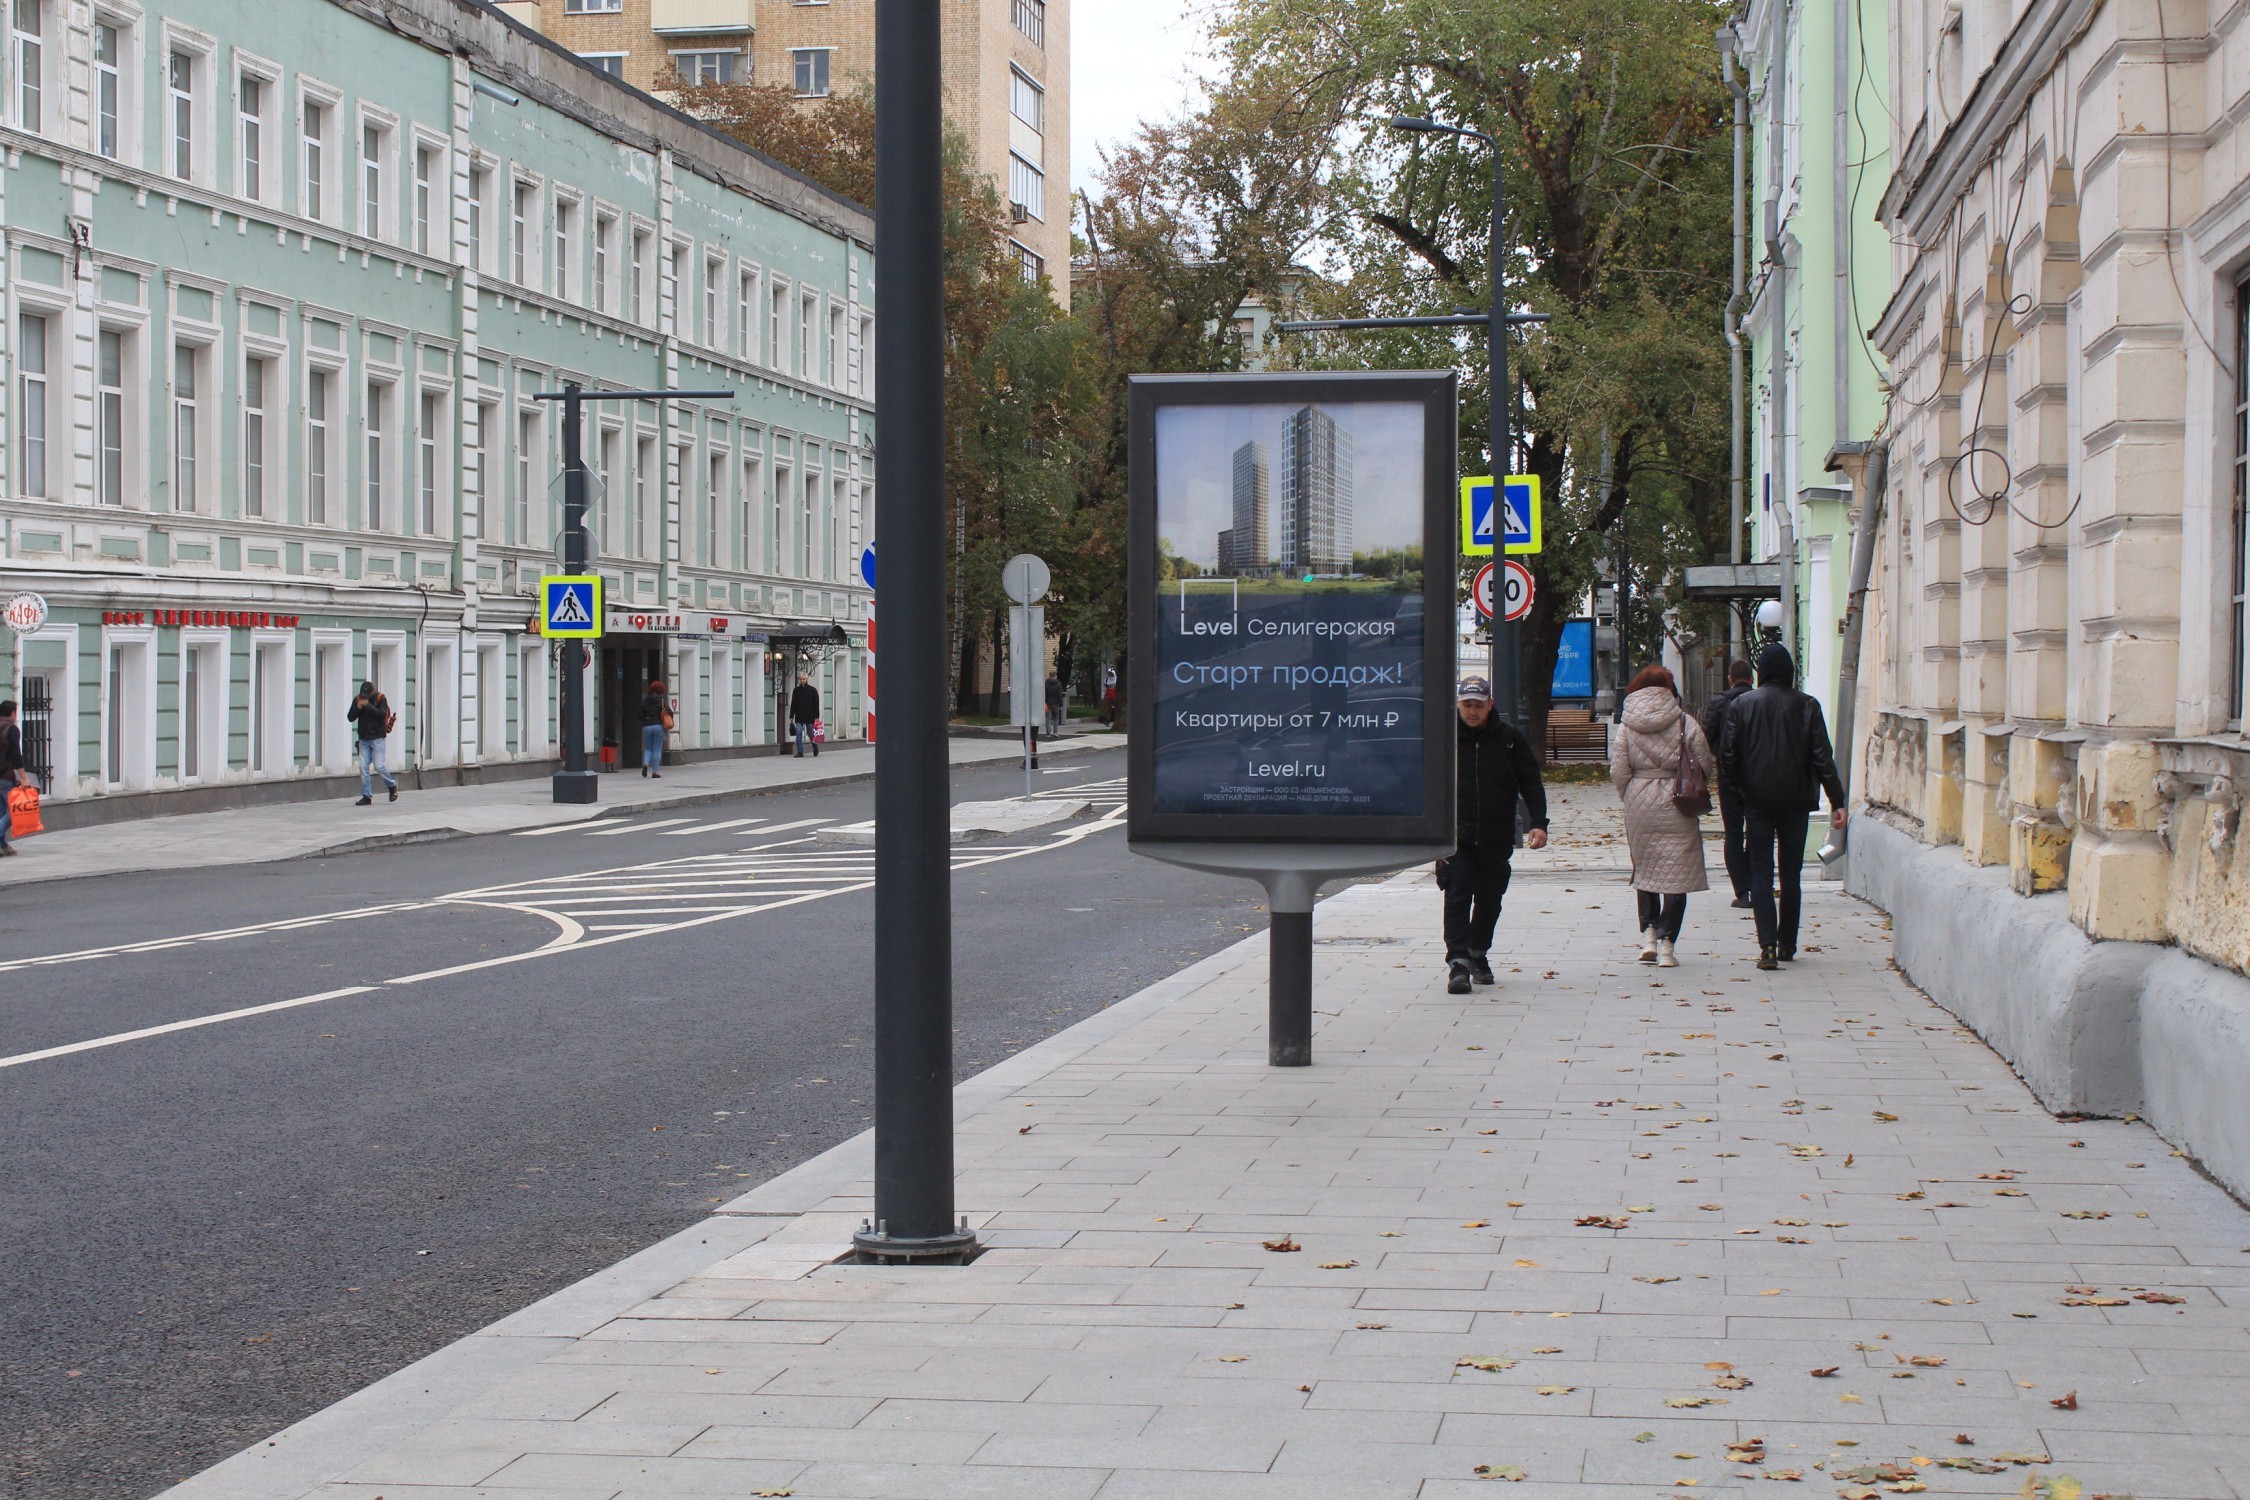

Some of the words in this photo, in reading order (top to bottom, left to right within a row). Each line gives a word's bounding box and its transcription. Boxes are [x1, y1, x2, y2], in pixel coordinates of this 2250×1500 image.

[5, 592, 44, 613] ГРУЗИНСКАЯ
[9, 602, 39, 625] КАФЕ
[1181, 612, 1238, 636] Level
[1247, 618, 1396, 641] Селигерская
[1173, 661, 1263, 691] Старт
[1273, 662, 1402, 691] продаж!
[1176, 710, 1282, 732] Квартиры
[1290, 714, 1314, 728] от
[1320, 711, 1331, 728] 7
[1338, 714, 1379, 728] млн
[1248, 760, 1326, 777] Level.ru
[1243, 794, 1287, 802] ДЕКЛАРАЦИЯ
